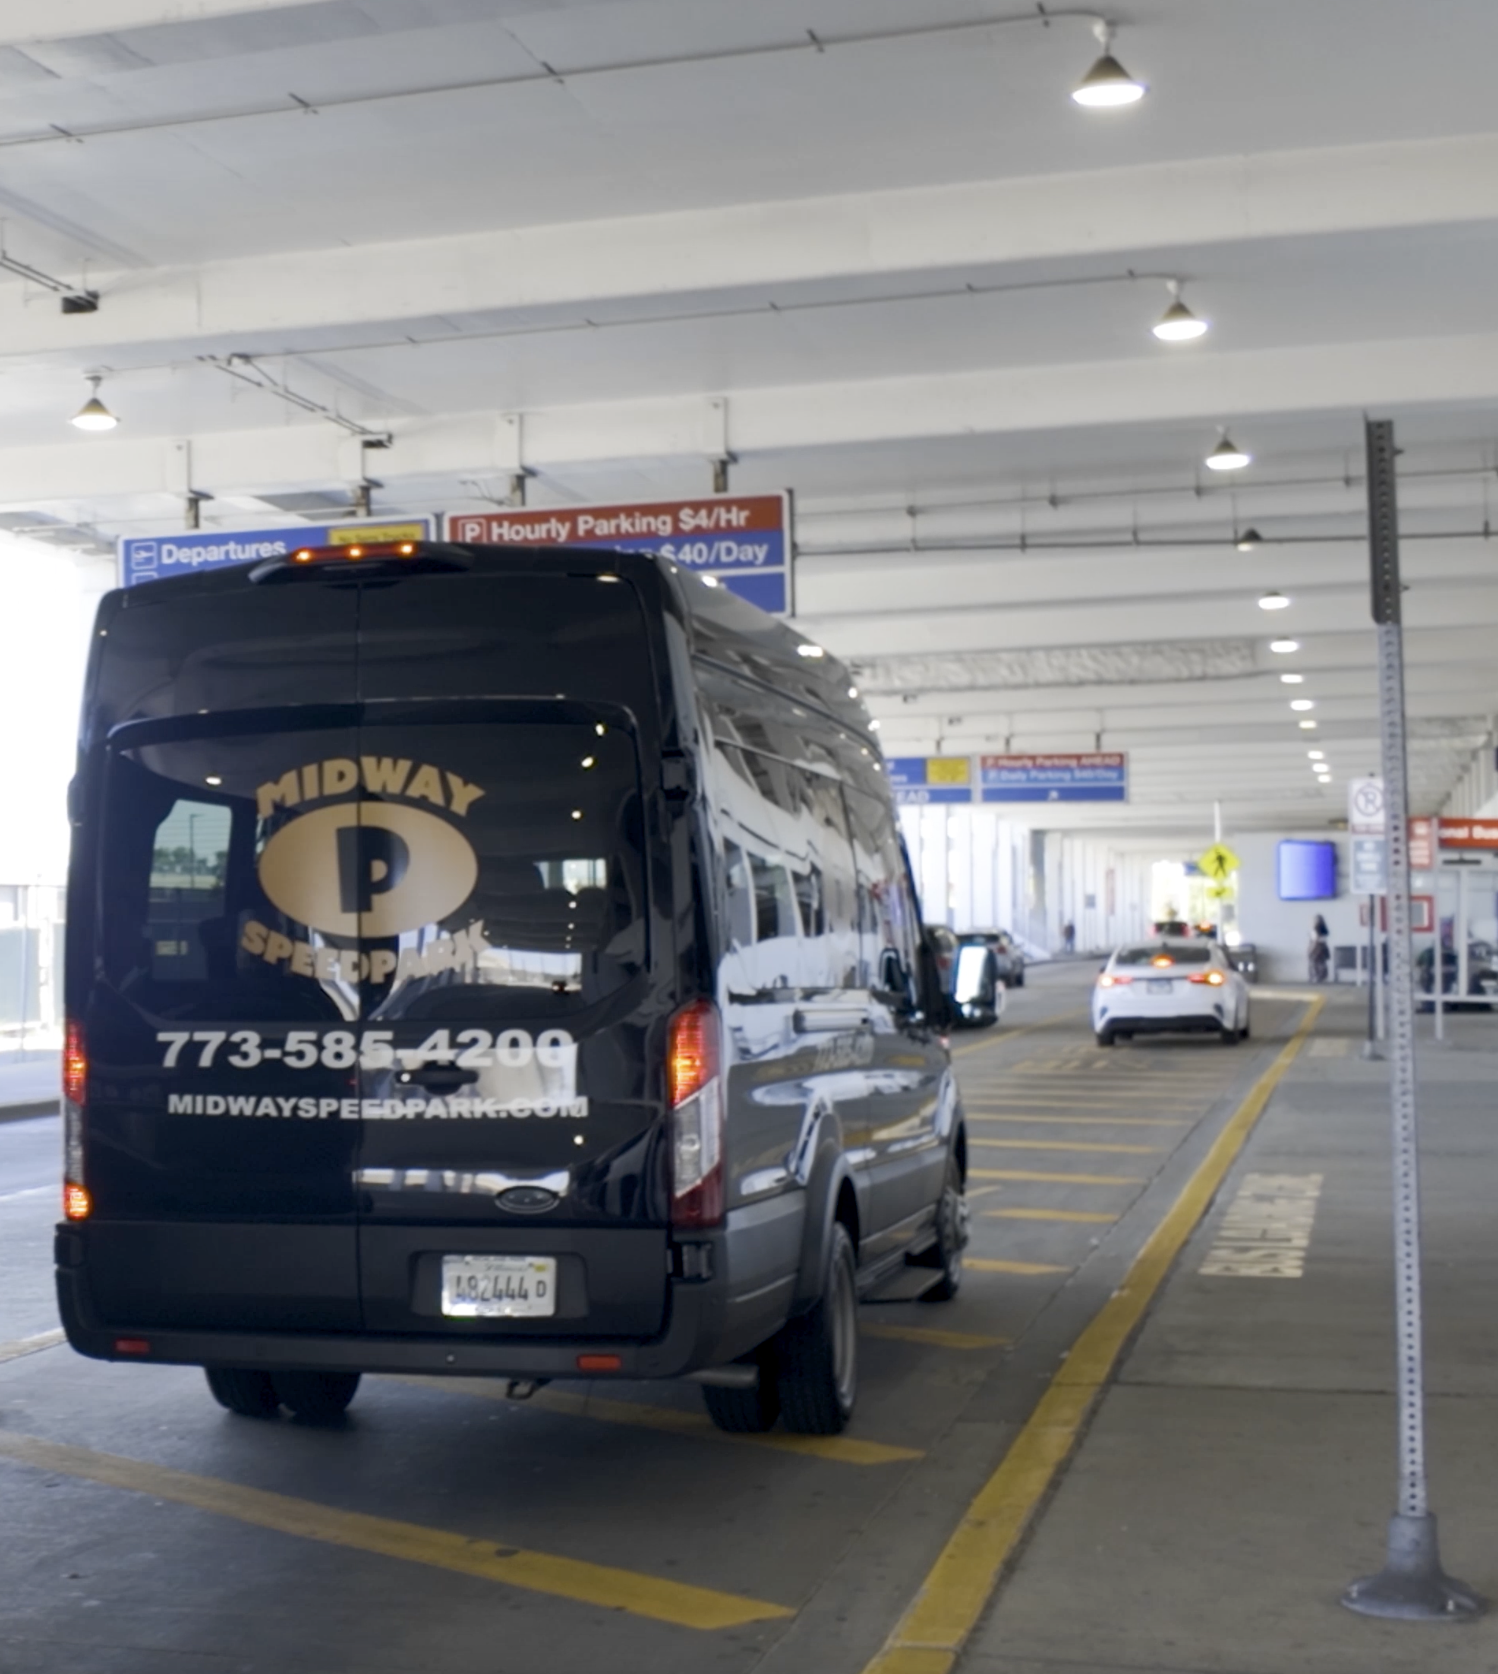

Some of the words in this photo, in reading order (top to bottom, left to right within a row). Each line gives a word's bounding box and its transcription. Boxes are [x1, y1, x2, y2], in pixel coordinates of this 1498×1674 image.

[491, 518, 571, 543] Hourly
[577, 511, 672, 537] Parking
[678, 506, 749, 532] $4/Hr
[160, 539, 287, 566] Departures
[660, 540, 769, 565] $40/Day
[1000, 769, 1028, 782] Daily
[1030, 768, 1071, 781] Parking
[1035, 755, 1078, 768] Parking
[1079, 754, 1121, 767] AHEAD
[256, 755, 486, 820] MIDWAY
[335, 825, 410, 915] P
[241, 918, 493, 985] SPEEDPARK
[155, 1028, 576, 1070] 773-585-4200
[167, 1094, 589, 1120] MIDWAYSPEEDPARK.COM
